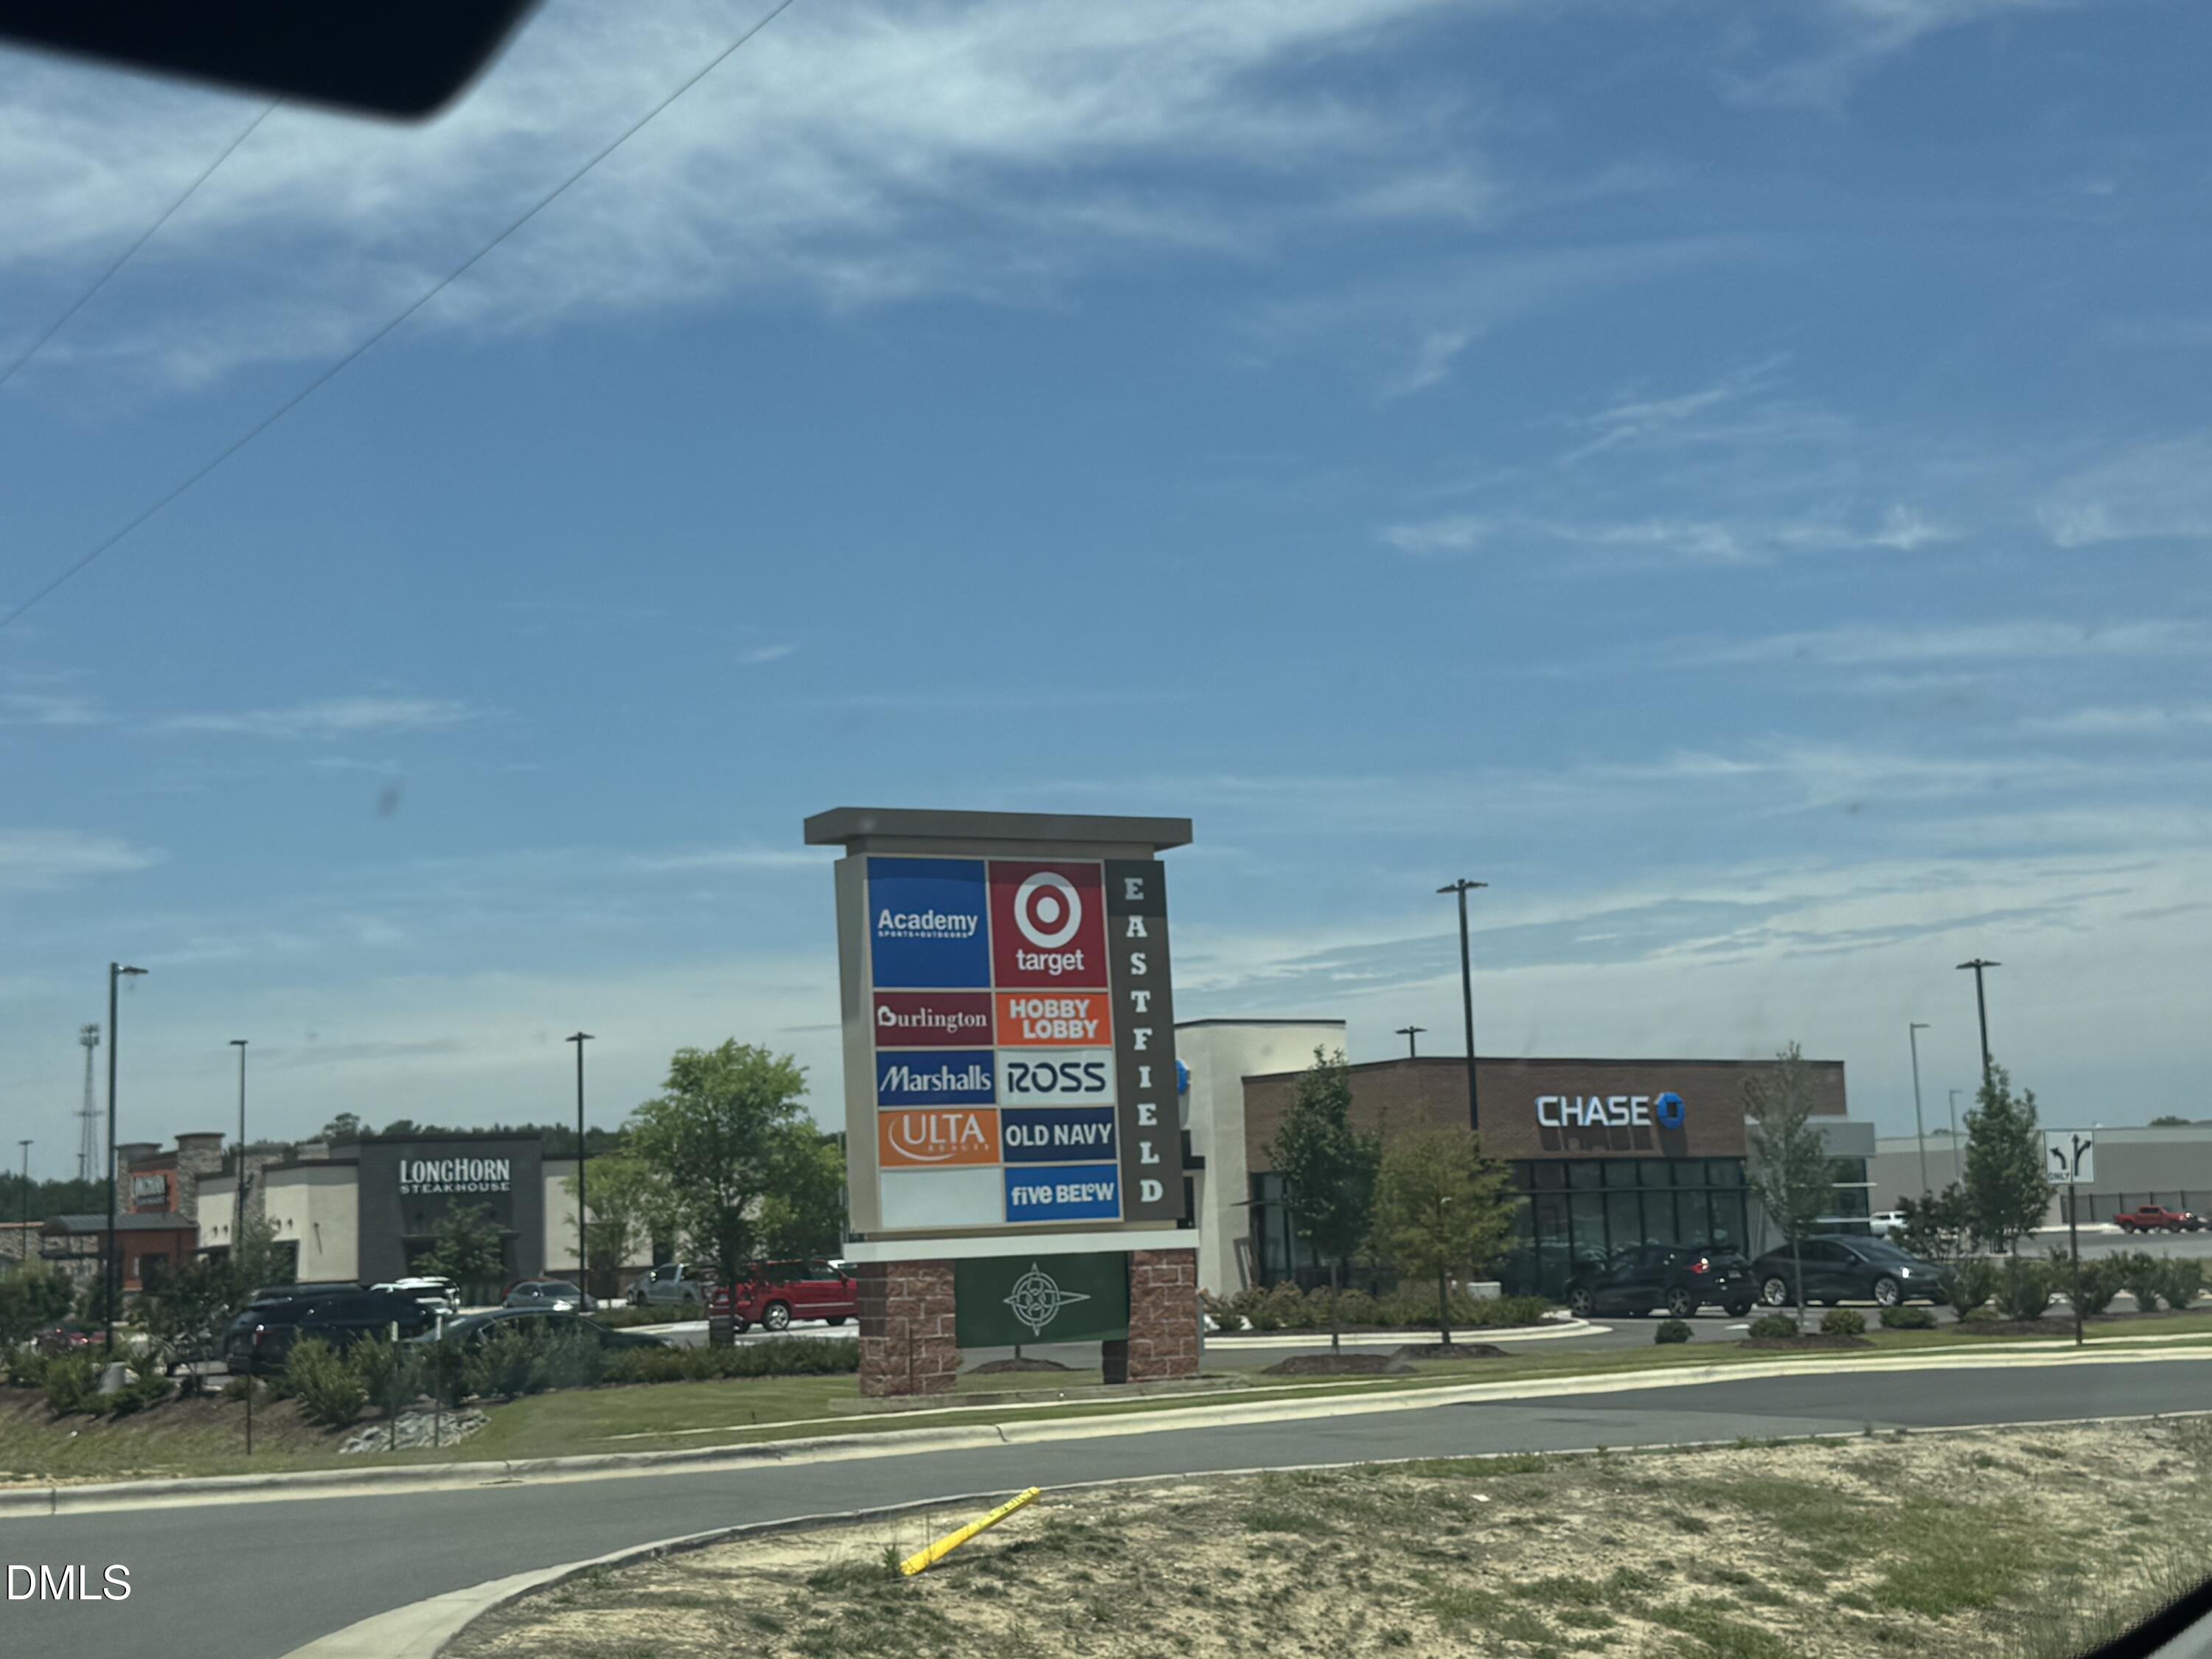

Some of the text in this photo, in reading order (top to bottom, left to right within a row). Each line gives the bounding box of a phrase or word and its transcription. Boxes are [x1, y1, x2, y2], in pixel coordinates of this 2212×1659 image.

[877, 908, 978, 936] Academy
[1015, 948, 1085, 976] target
[877, 1005, 987, 1033] Burlington
[1009, 999, 1091, 1019] HOBBY
[1023, 1019, 1099, 1040] LOBBY
[1124, 877, 1164, 1202] EASTFIELD
[880, 1065, 992, 1092] Marshalls
[1007, 1062, 1106, 1093] ROSS
[1535, 1095, 1652, 1127] CHASE
[902, 1113, 986, 1144] ULTA
[1005, 1123, 1113, 1147] OLD NAVY
[400, 1158, 510, 1183] LONGHORN
[400, 1182, 510, 1194] STEAKHOUSE
[1011, 1185, 1054, 1206] five
